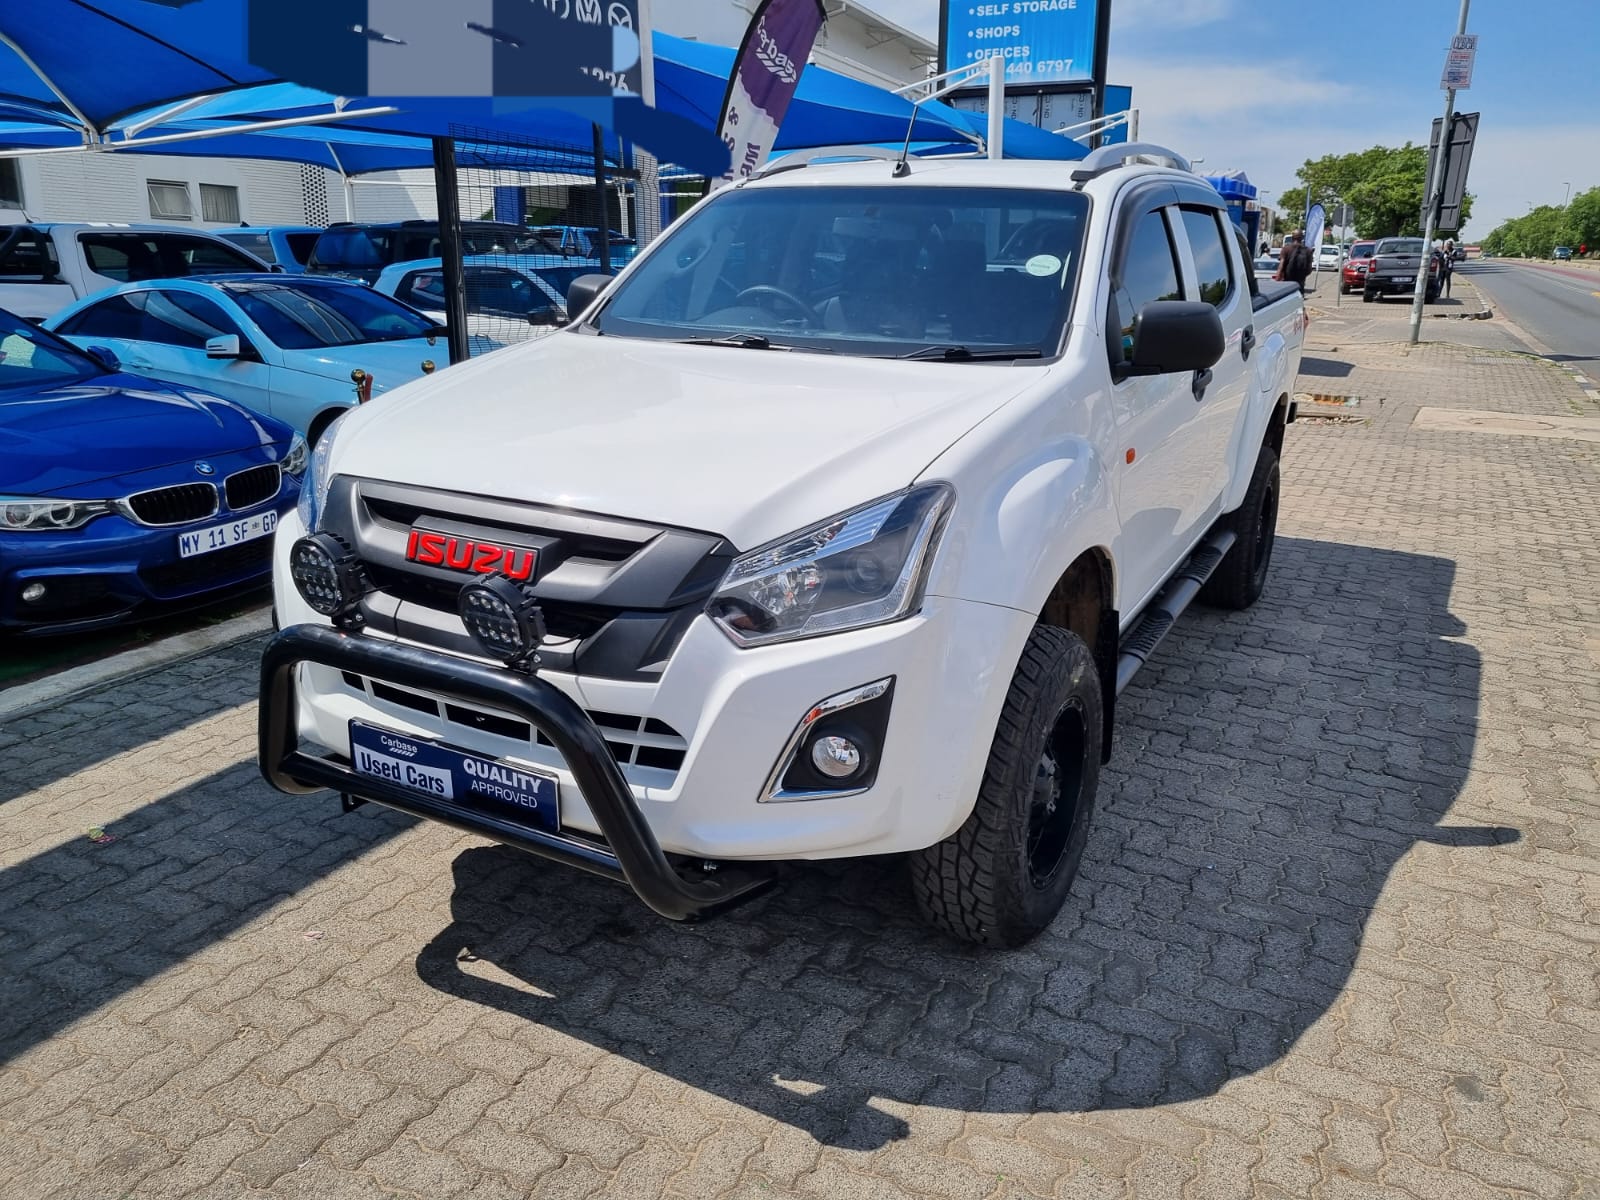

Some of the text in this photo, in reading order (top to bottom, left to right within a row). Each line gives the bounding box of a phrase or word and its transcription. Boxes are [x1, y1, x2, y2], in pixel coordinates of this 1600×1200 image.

[977, 0, 1077, 17] SELF STORAGE
[975, 25, 1020, 39] SHOPS
[974, 46, 1030, 60] OFFICES
[1006, 59, 1073, 74] 440 6797
[181, 512, 277, 555] MY 11 SF GP
[406, 530, 535, 580] ISUZU
[381, 735, 418, 754] Carbase
[361, 751, 445, 794] Used Cars
[463, 758, 542, 794] QUALITY
[471, 780, 538, 809] APPROVED
